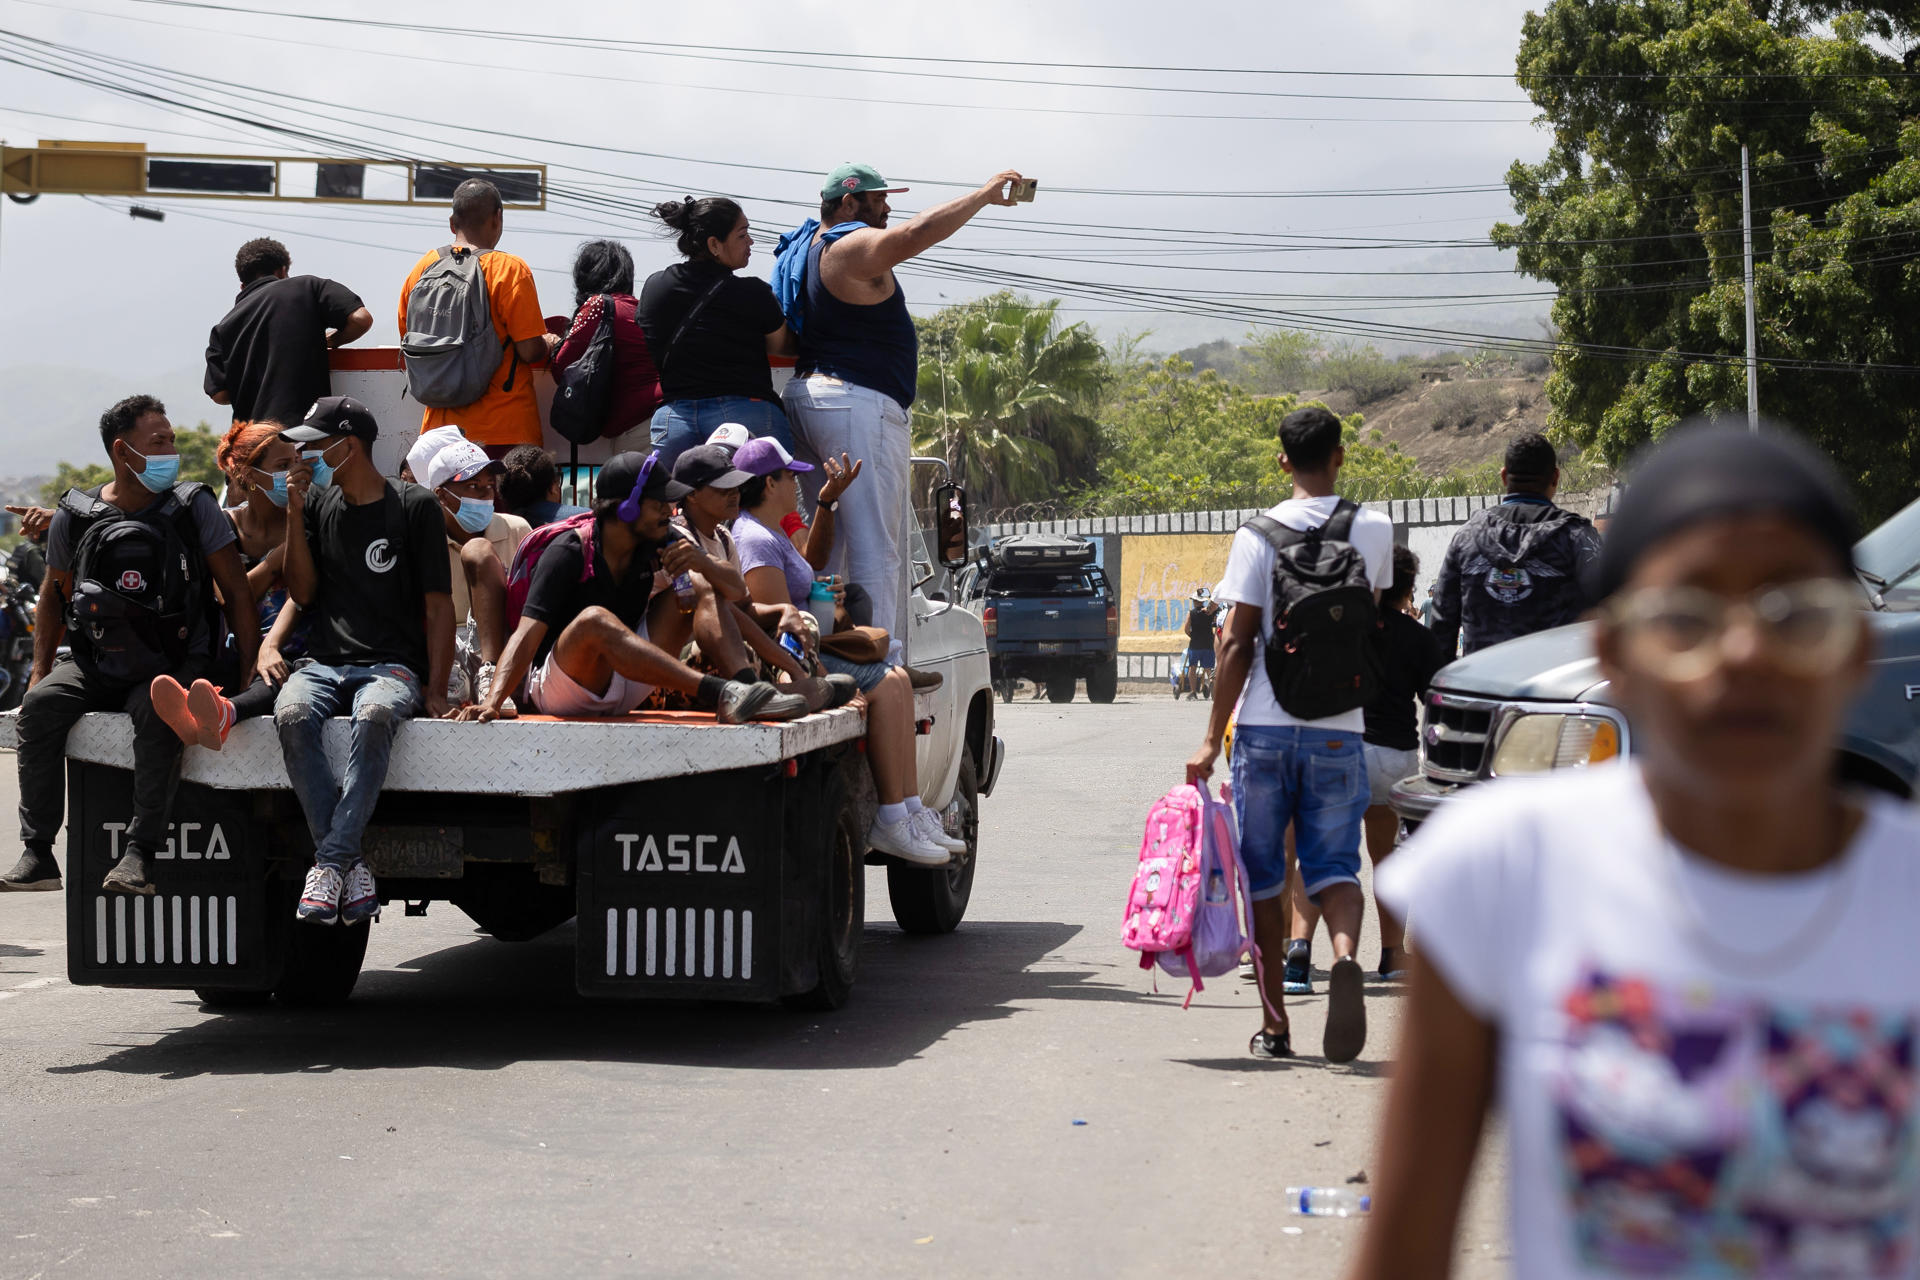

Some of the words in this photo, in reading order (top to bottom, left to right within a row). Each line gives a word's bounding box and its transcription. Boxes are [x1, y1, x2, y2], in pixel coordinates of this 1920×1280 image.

[1138, 599, 1209, 631] MAD
[102, 822, 231, 860] TSCA
[614, 833, 746, 874] TASCA
